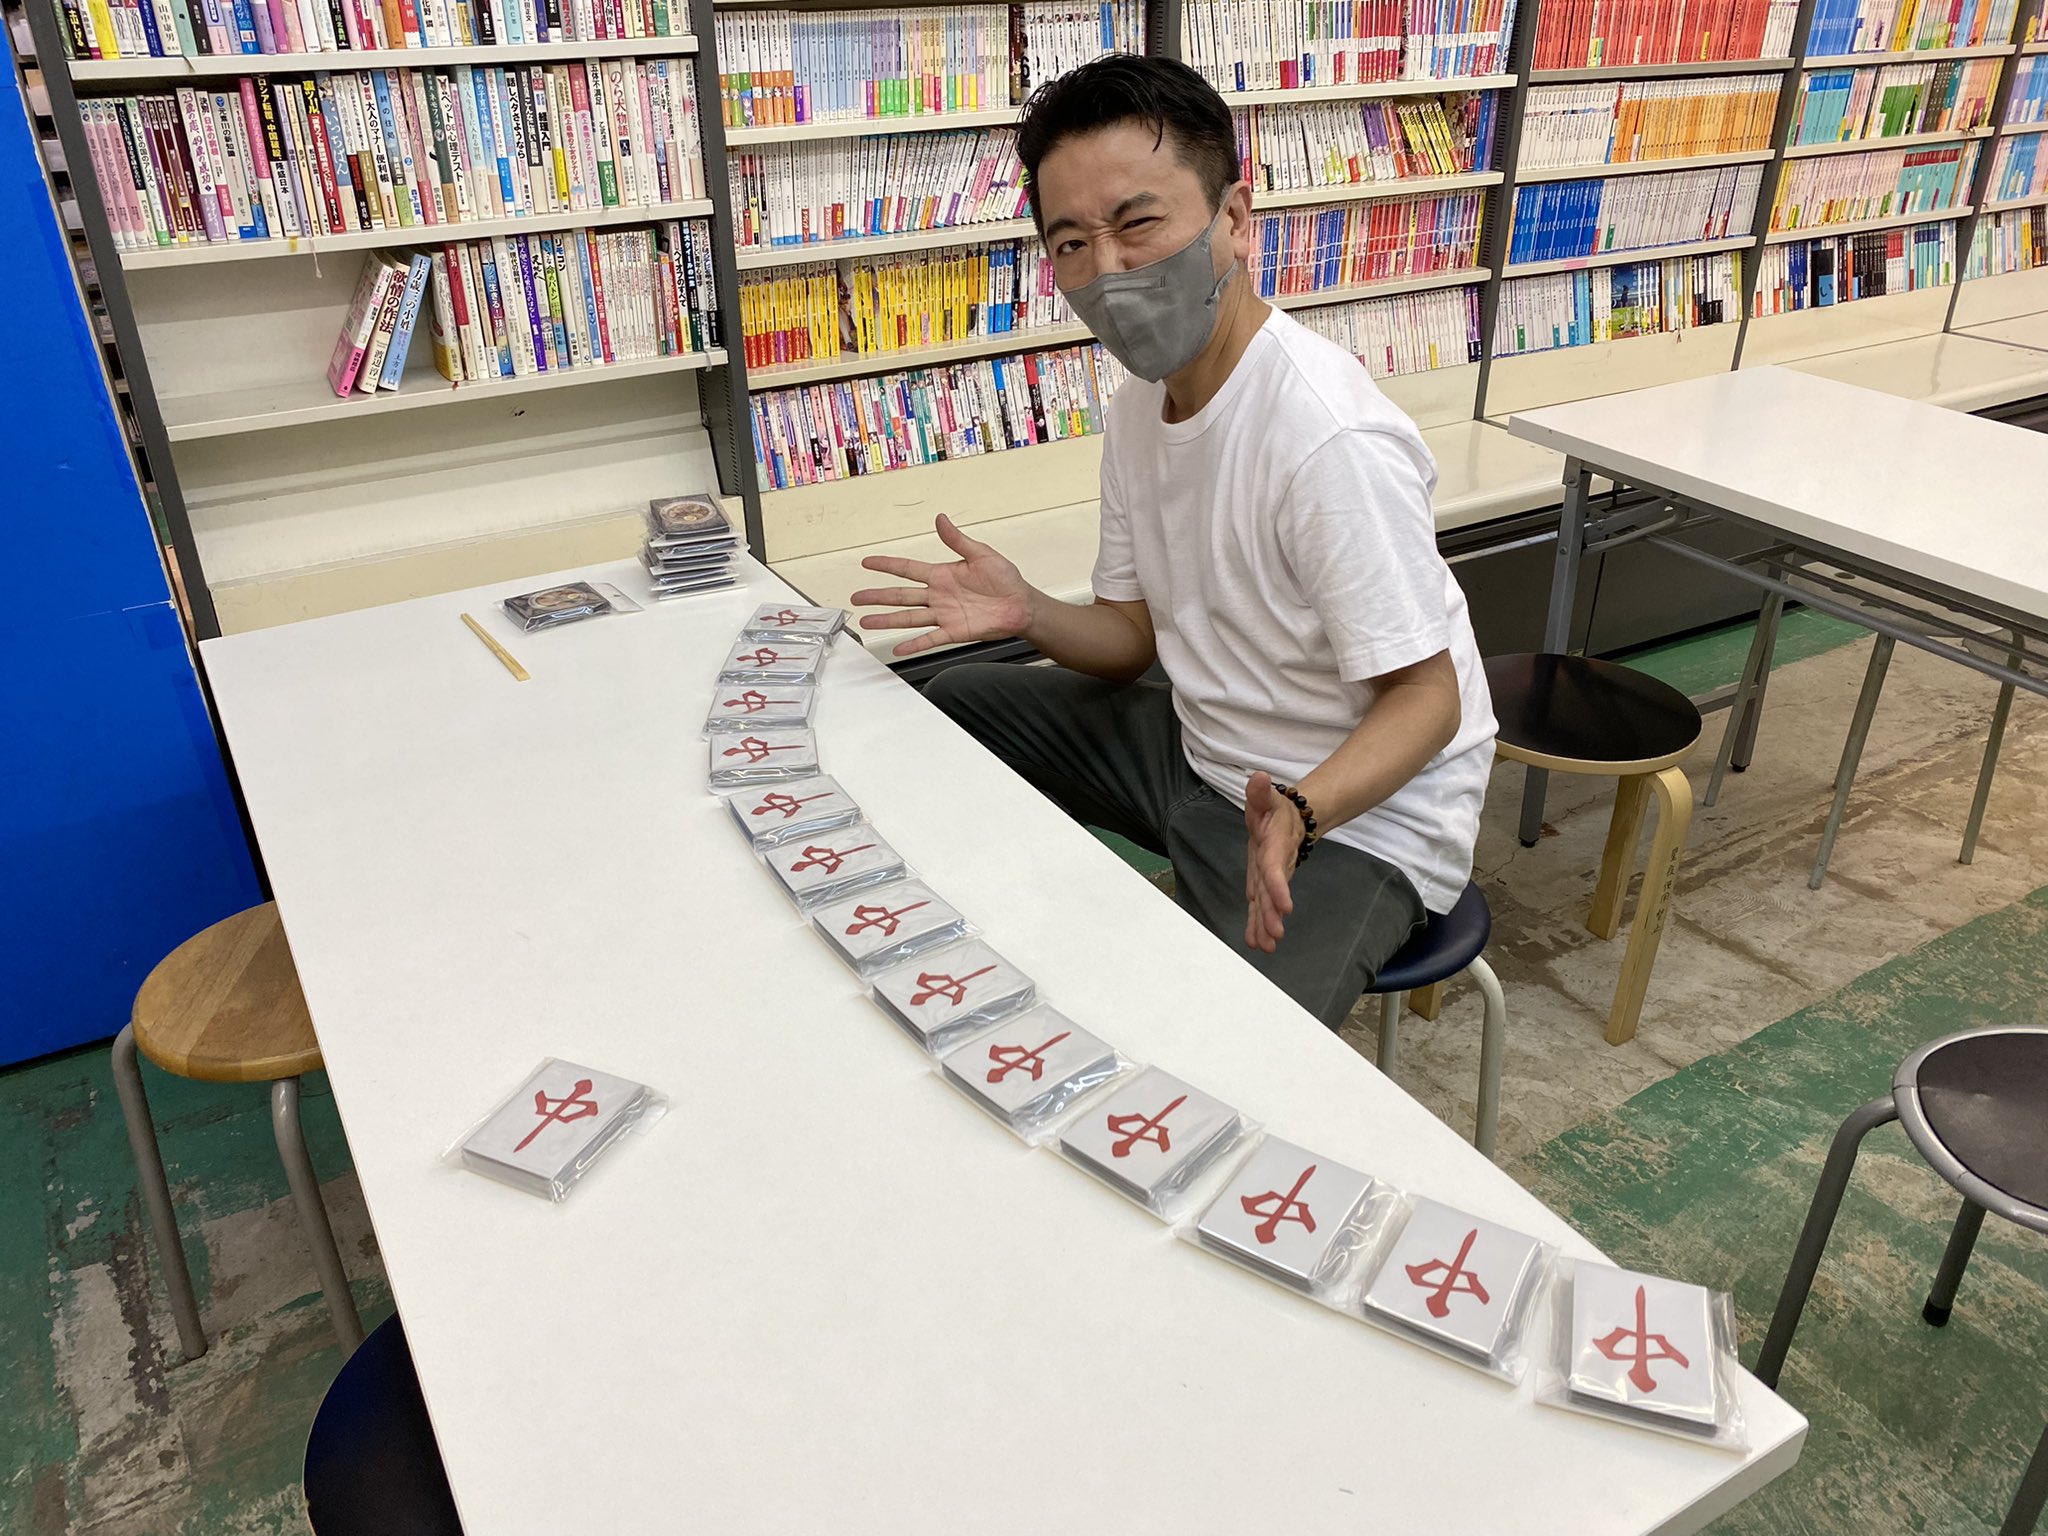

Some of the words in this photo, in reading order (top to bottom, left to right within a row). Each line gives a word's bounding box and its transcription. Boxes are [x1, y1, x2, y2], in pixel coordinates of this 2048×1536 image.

[589, 63, 604, 107] 五体不満足
[610, 70, 630, 138] のら犬物語
[364, 101, 389, 183] 大人のマナー便利帳
[506, 77, 527, 160] 話しベタさようなら
[537, 111, 552, 152] 経理入門
[598, 120, 609, 149] 乙武洋匡
[323, 114, 349, 178] いっちばん
[275, 162, 290, 194] 隆盛日本
[554, 237, 567, 272] リモコン
[377, 269, 408, 335] 欲情の作法
[400, 258, 429, 332] 土方歳三の小姓
[674, 250, 687, 308] ペイオフのすべて
[760, 610, 826, 627] 中
[736, 648, 808, 667] 中
[722, 690, 800, 713] 中
[722, 737, 805, 763] 中
[750, 792, 834, 818] 中
[790, 844, 876, 875] 中
[845, 901, 931, 936] 中
[909, 964, 997, 1006] 中
[987, 1031, 1071, 1084] 中
[513, 1079, 599, 1153] 中
[1107, 1095, 1188, 1158] 中
[1240, 1165, 1317, 1244] 中
[1405, 1229, 1490, 1318] 中
[1592, 1285, 1690, 1393] 中
